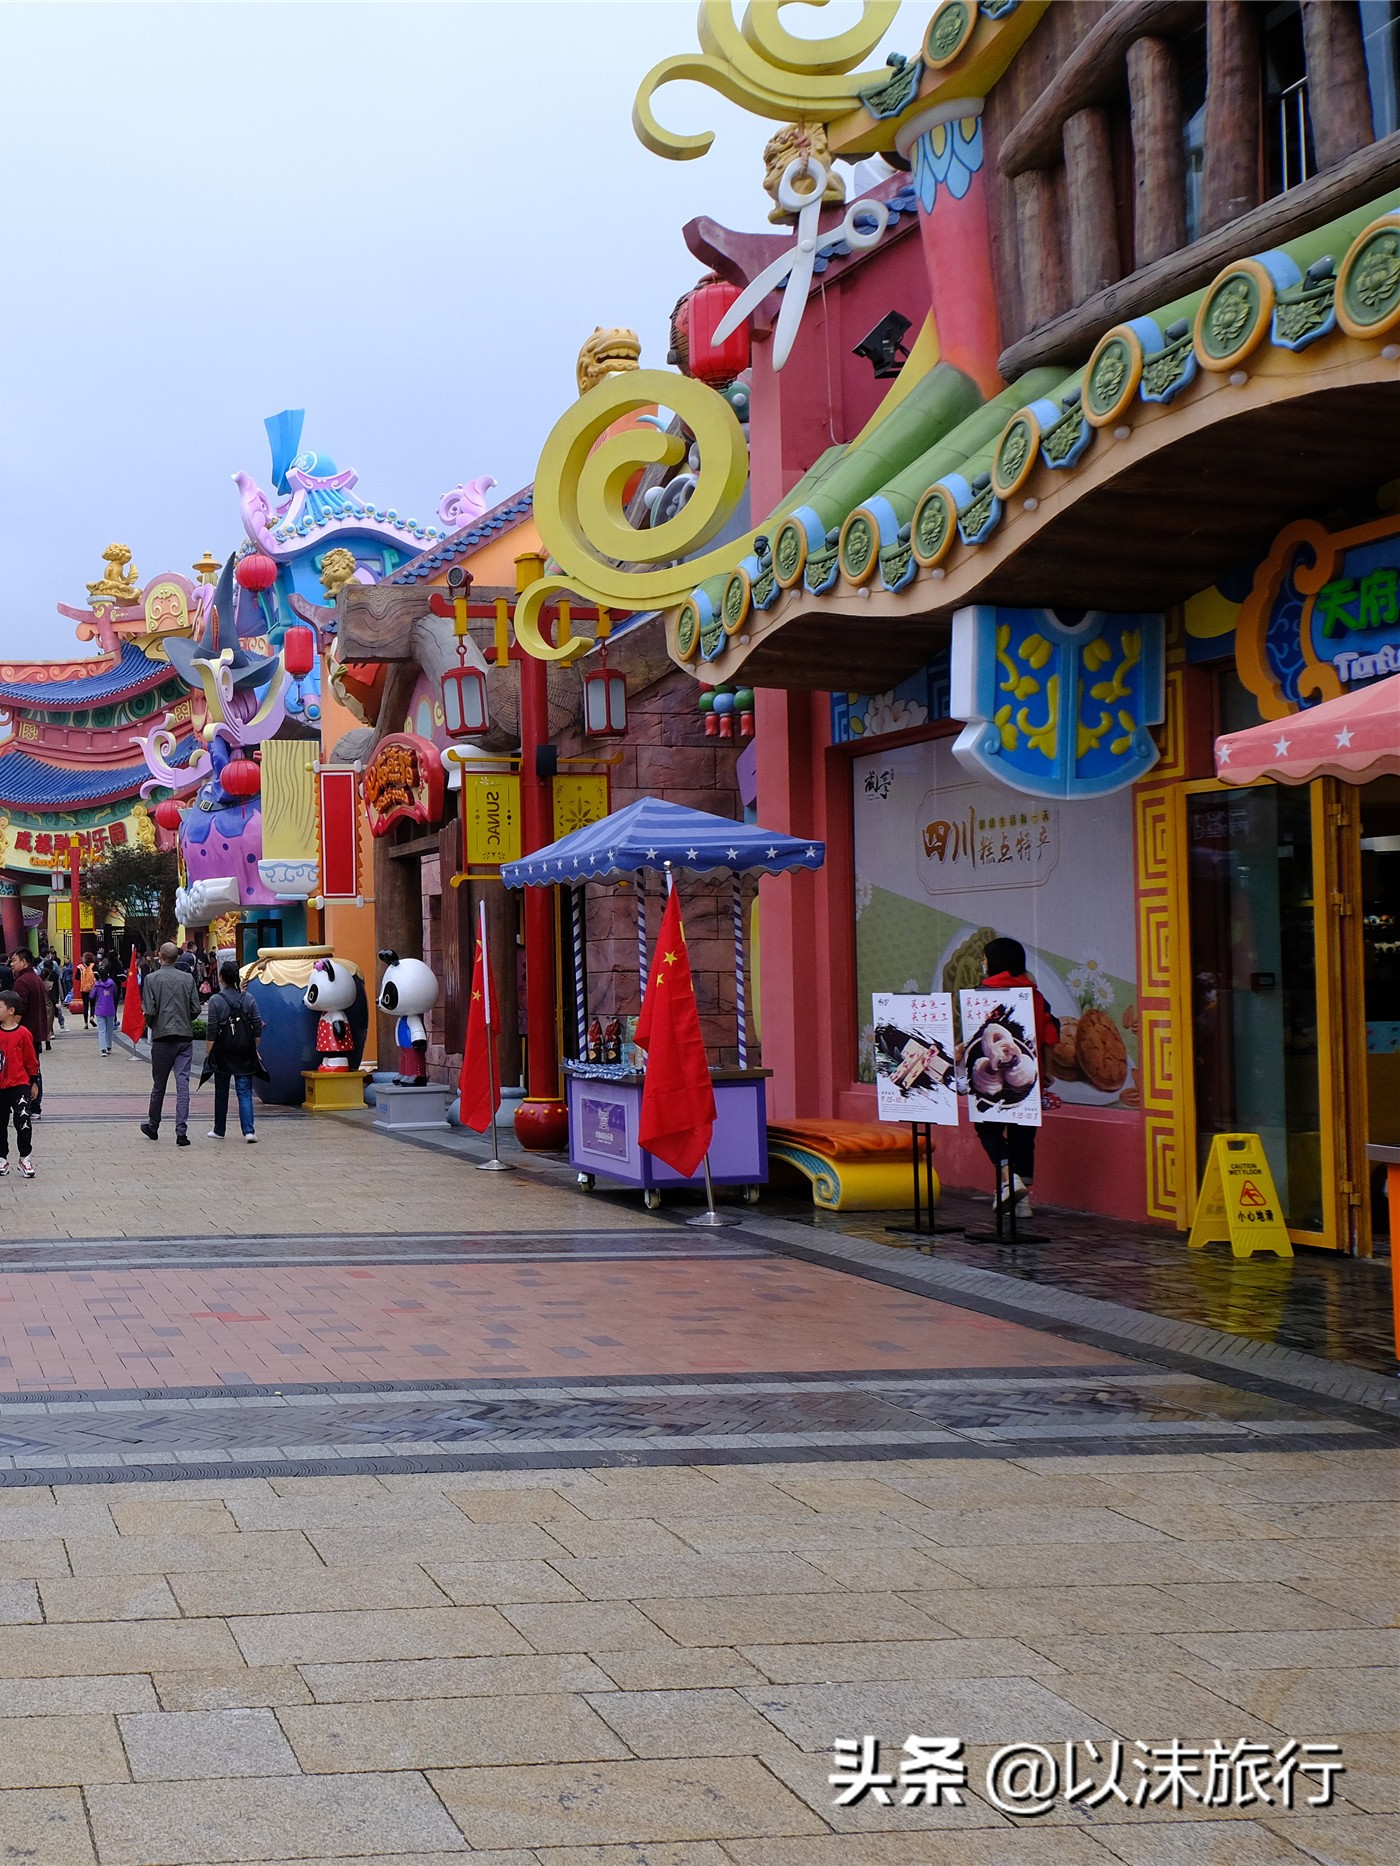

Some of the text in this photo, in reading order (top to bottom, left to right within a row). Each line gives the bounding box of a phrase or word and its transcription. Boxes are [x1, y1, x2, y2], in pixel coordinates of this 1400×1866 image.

[1318, 568, 1399, 638] 天府
[922, 805, 976, 870] 四川
[978, 825, 1051, 866] 糕点特产
[1238, 1209, 1274, 1223] 小心地滑
